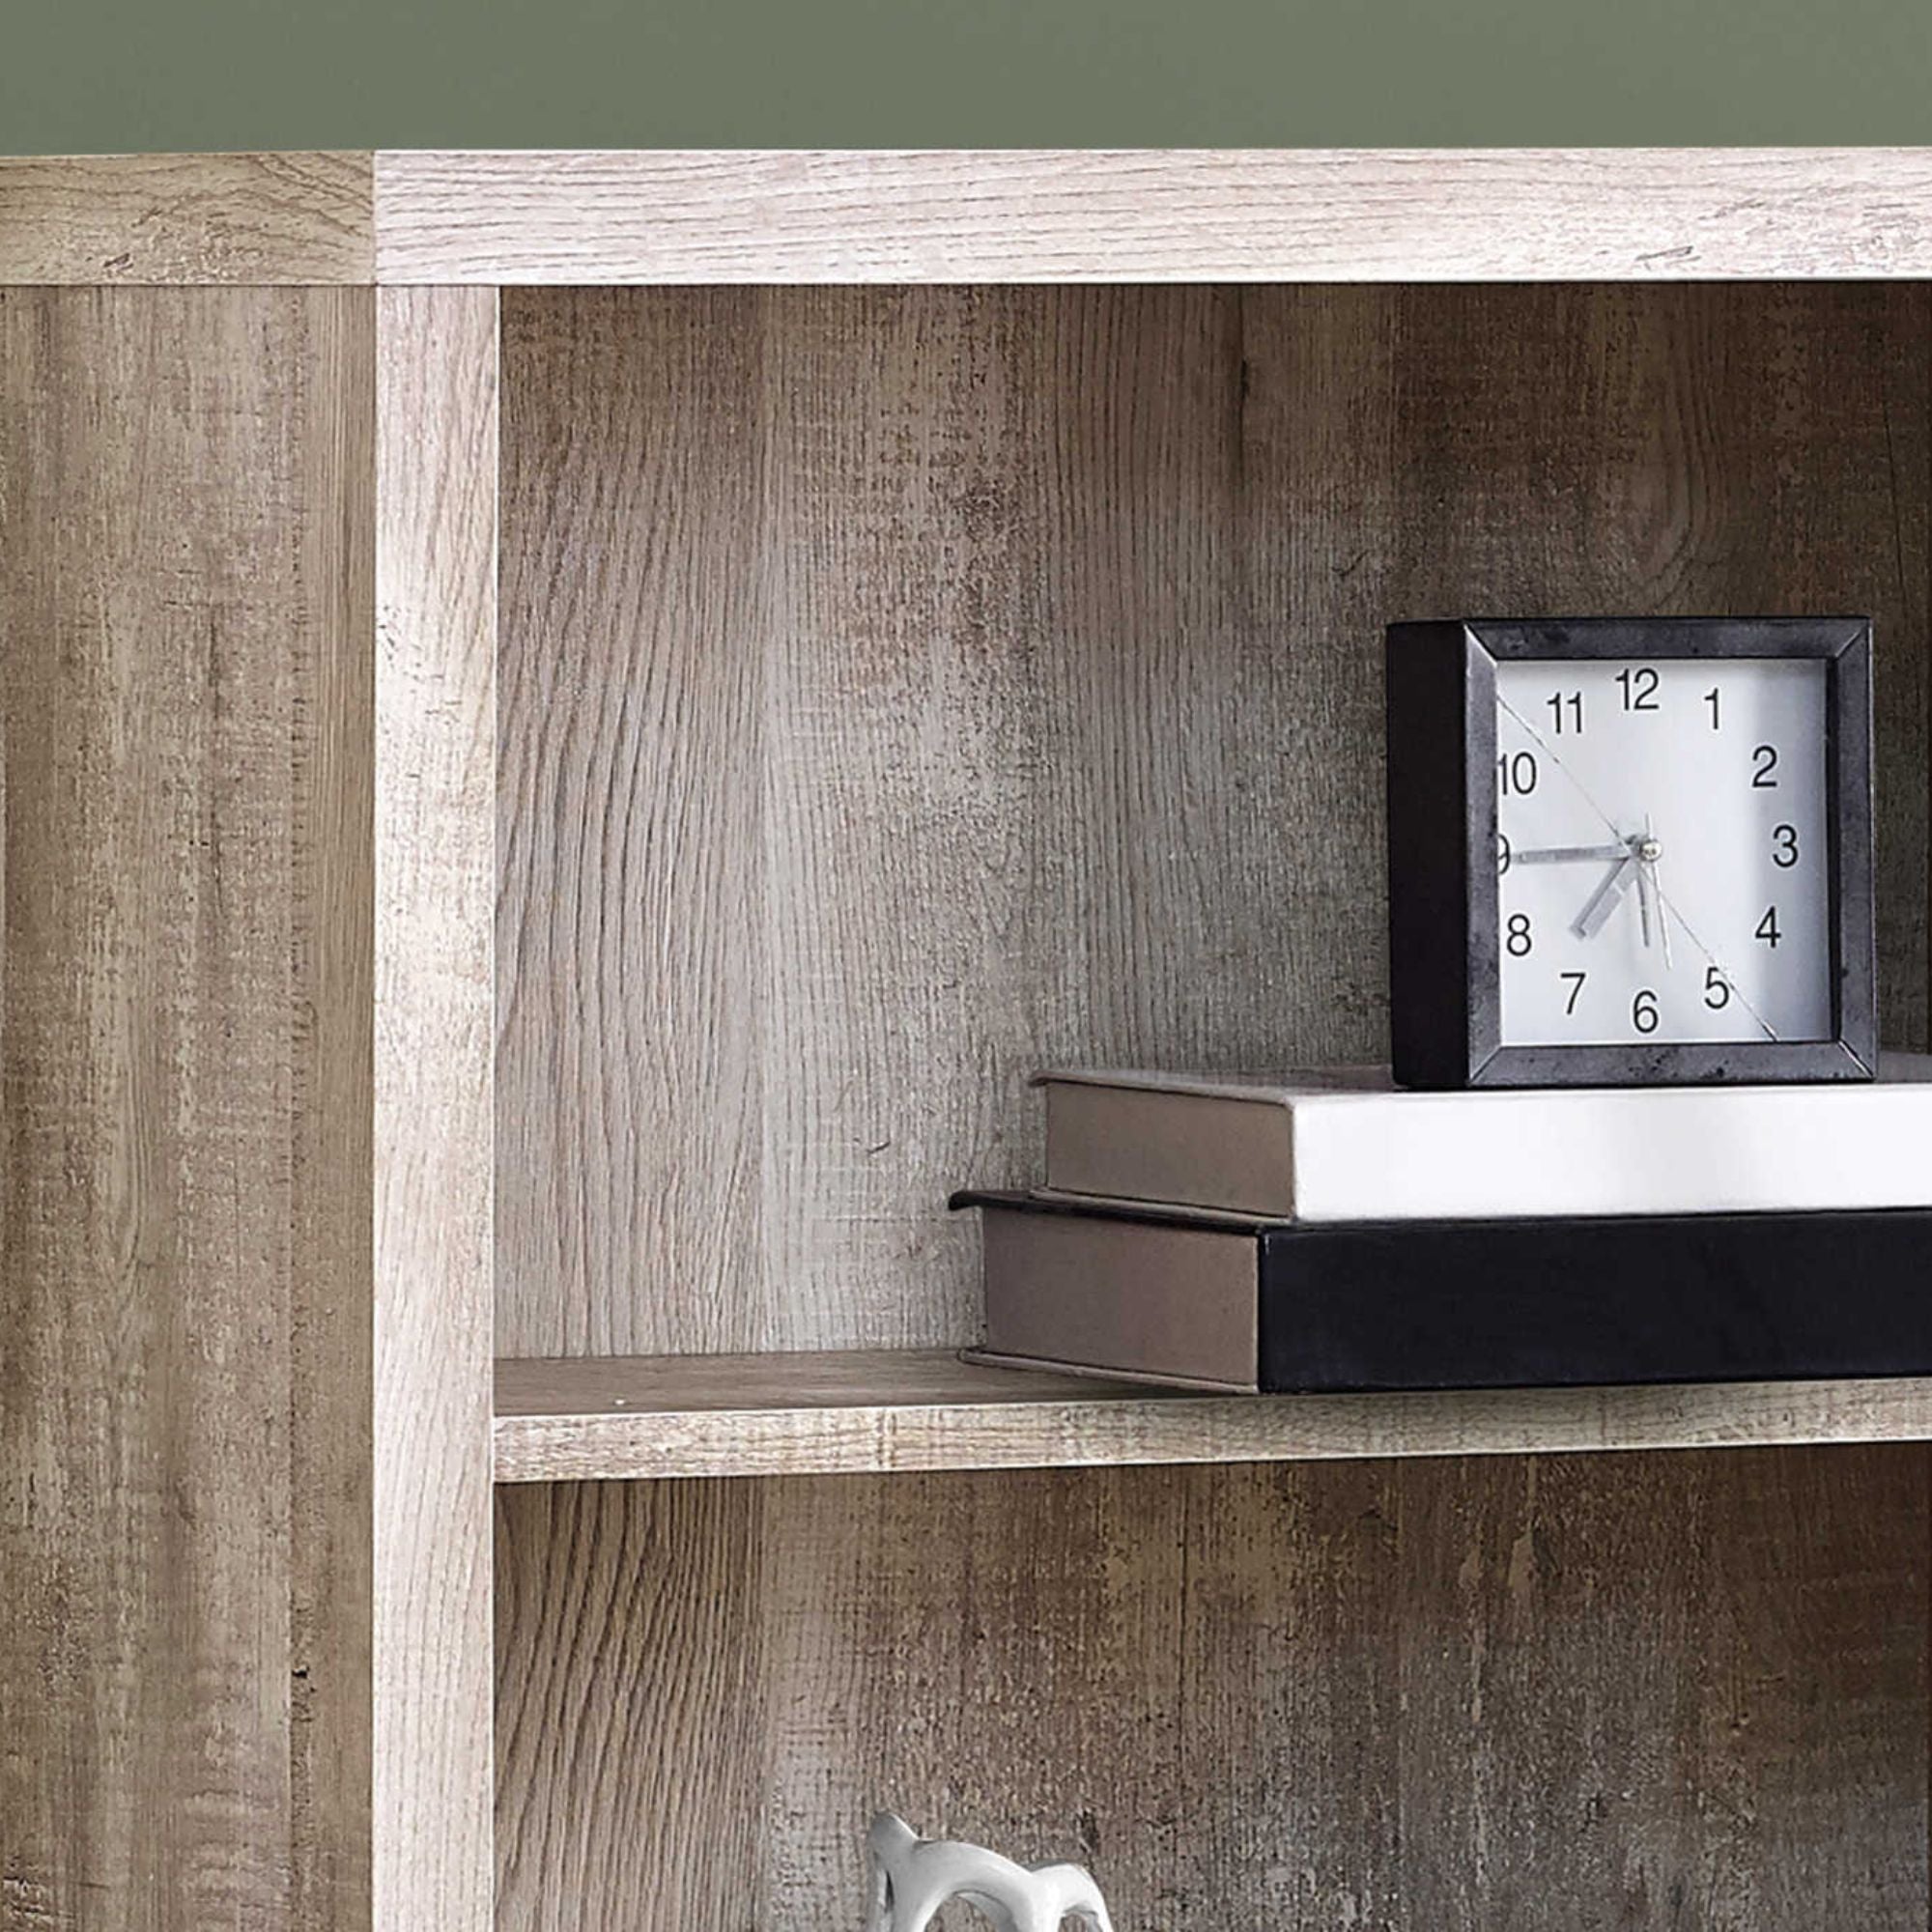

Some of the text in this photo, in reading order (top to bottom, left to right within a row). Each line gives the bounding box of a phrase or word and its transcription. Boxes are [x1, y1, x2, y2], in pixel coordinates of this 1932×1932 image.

[1615, 668, 1660, 710] 12
[1704, 688, 1719, 729] 1
[1547, 692, 1583, 733] 11
[1498, 753, 1537, 795] 10
[1751, 746, 1778, 787] 2
[1773, 825, 1799, 867] 3
[1506, 914, 1532, 956] 8
[1754, 907, 1781, 949] 4
[1560, 973, 1586, 1015] 7
[1704, 968, 1730, 1009] 5
[1633, 991, 1659, 1034] 6
